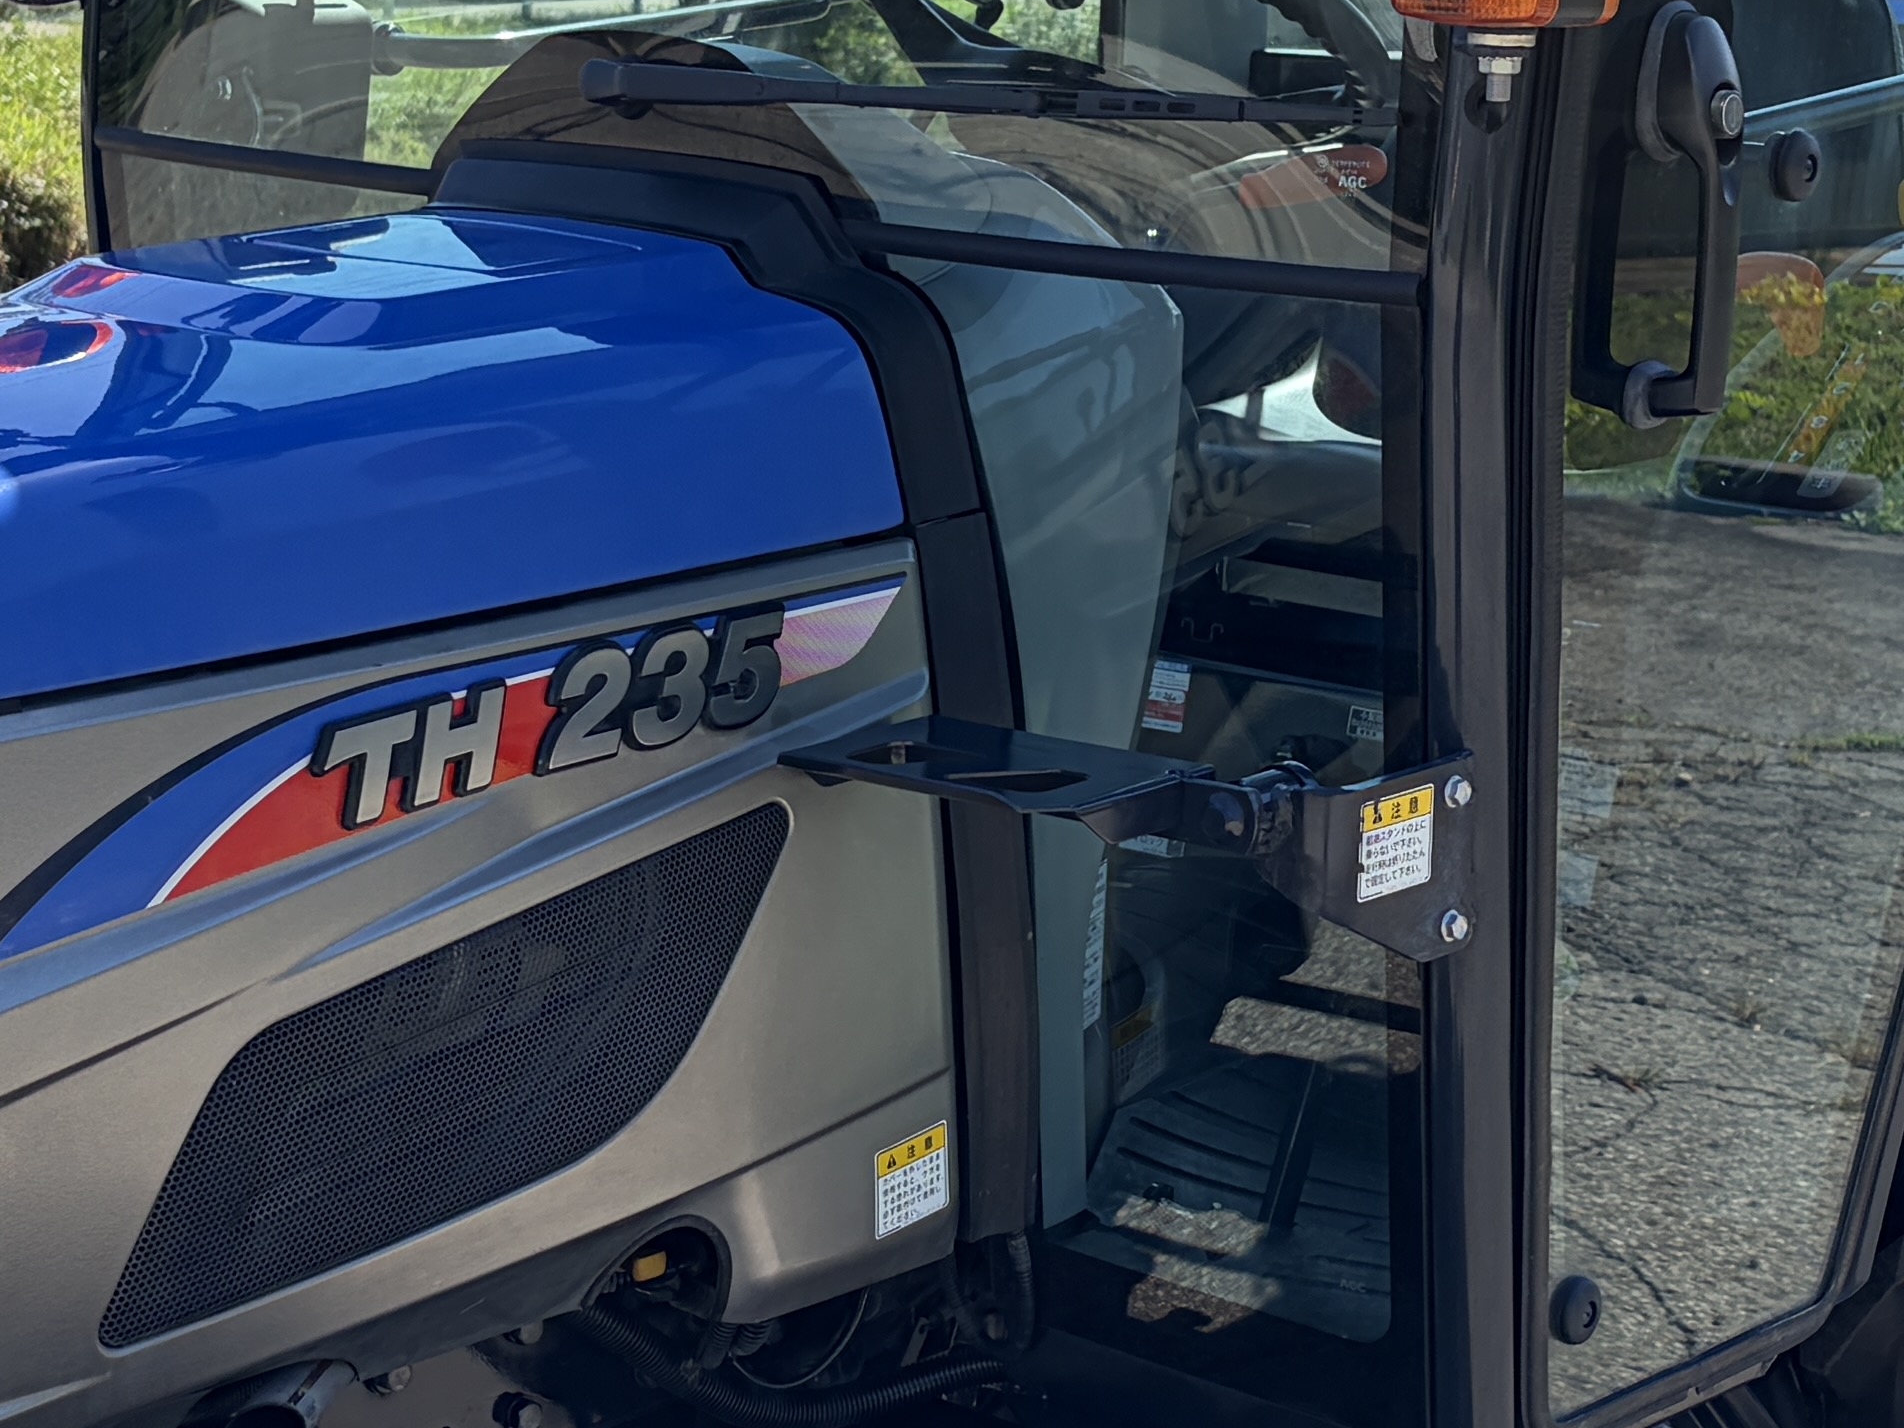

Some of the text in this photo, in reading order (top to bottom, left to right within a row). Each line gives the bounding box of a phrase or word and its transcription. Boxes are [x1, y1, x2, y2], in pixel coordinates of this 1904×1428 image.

[1338, 175, 1368, 189] AGC
[309, 602, 786, 830] TH 235
